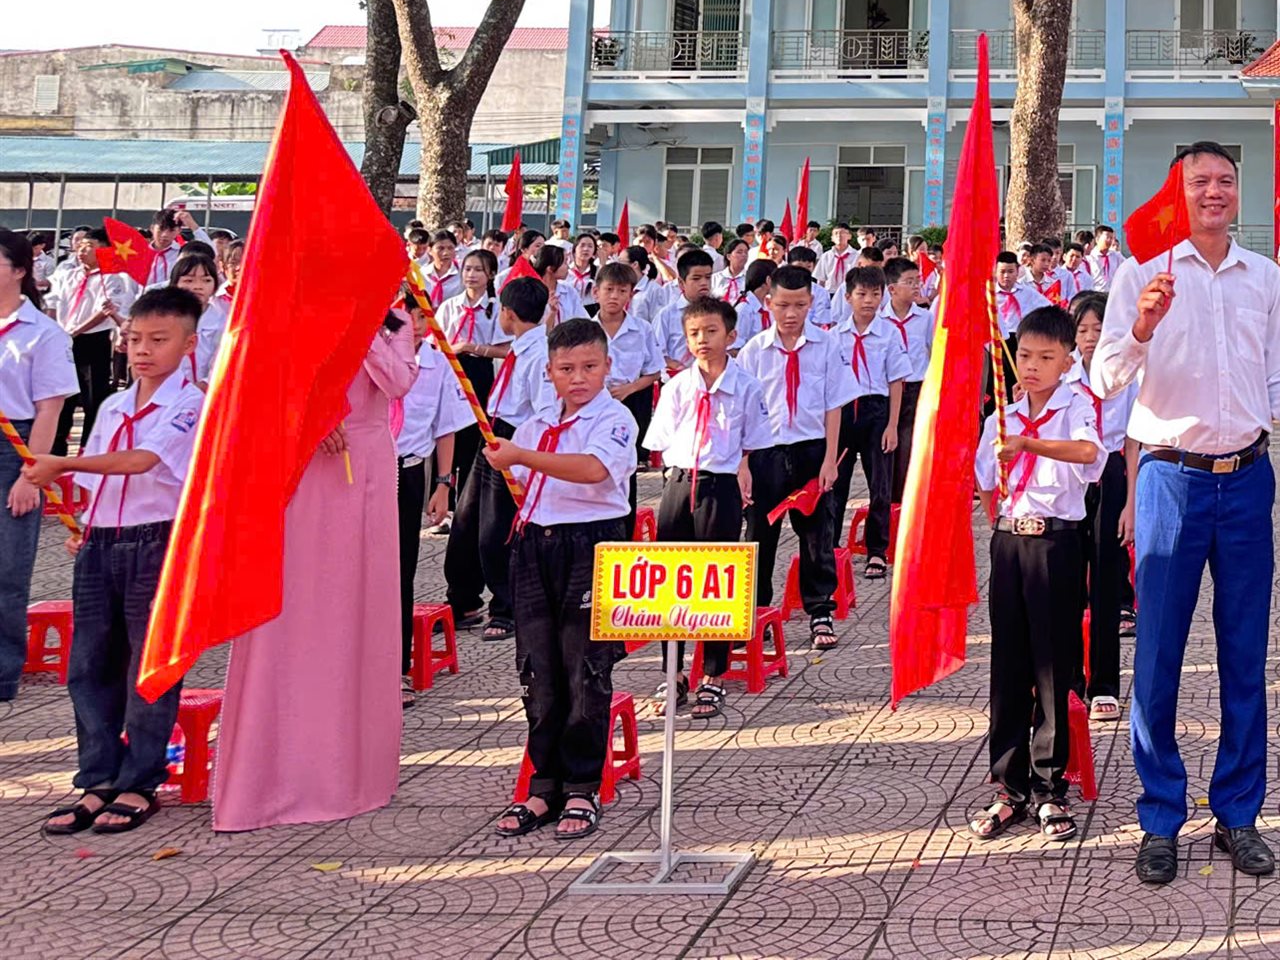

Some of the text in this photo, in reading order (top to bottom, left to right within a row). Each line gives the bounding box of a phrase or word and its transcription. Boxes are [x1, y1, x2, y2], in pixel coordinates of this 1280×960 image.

[194, 202, 236, 210] TRNSIT
[612, 556, 735, 599] LỚP 6 A1
[611, 604, 732, 631] Chăm Ngoan
